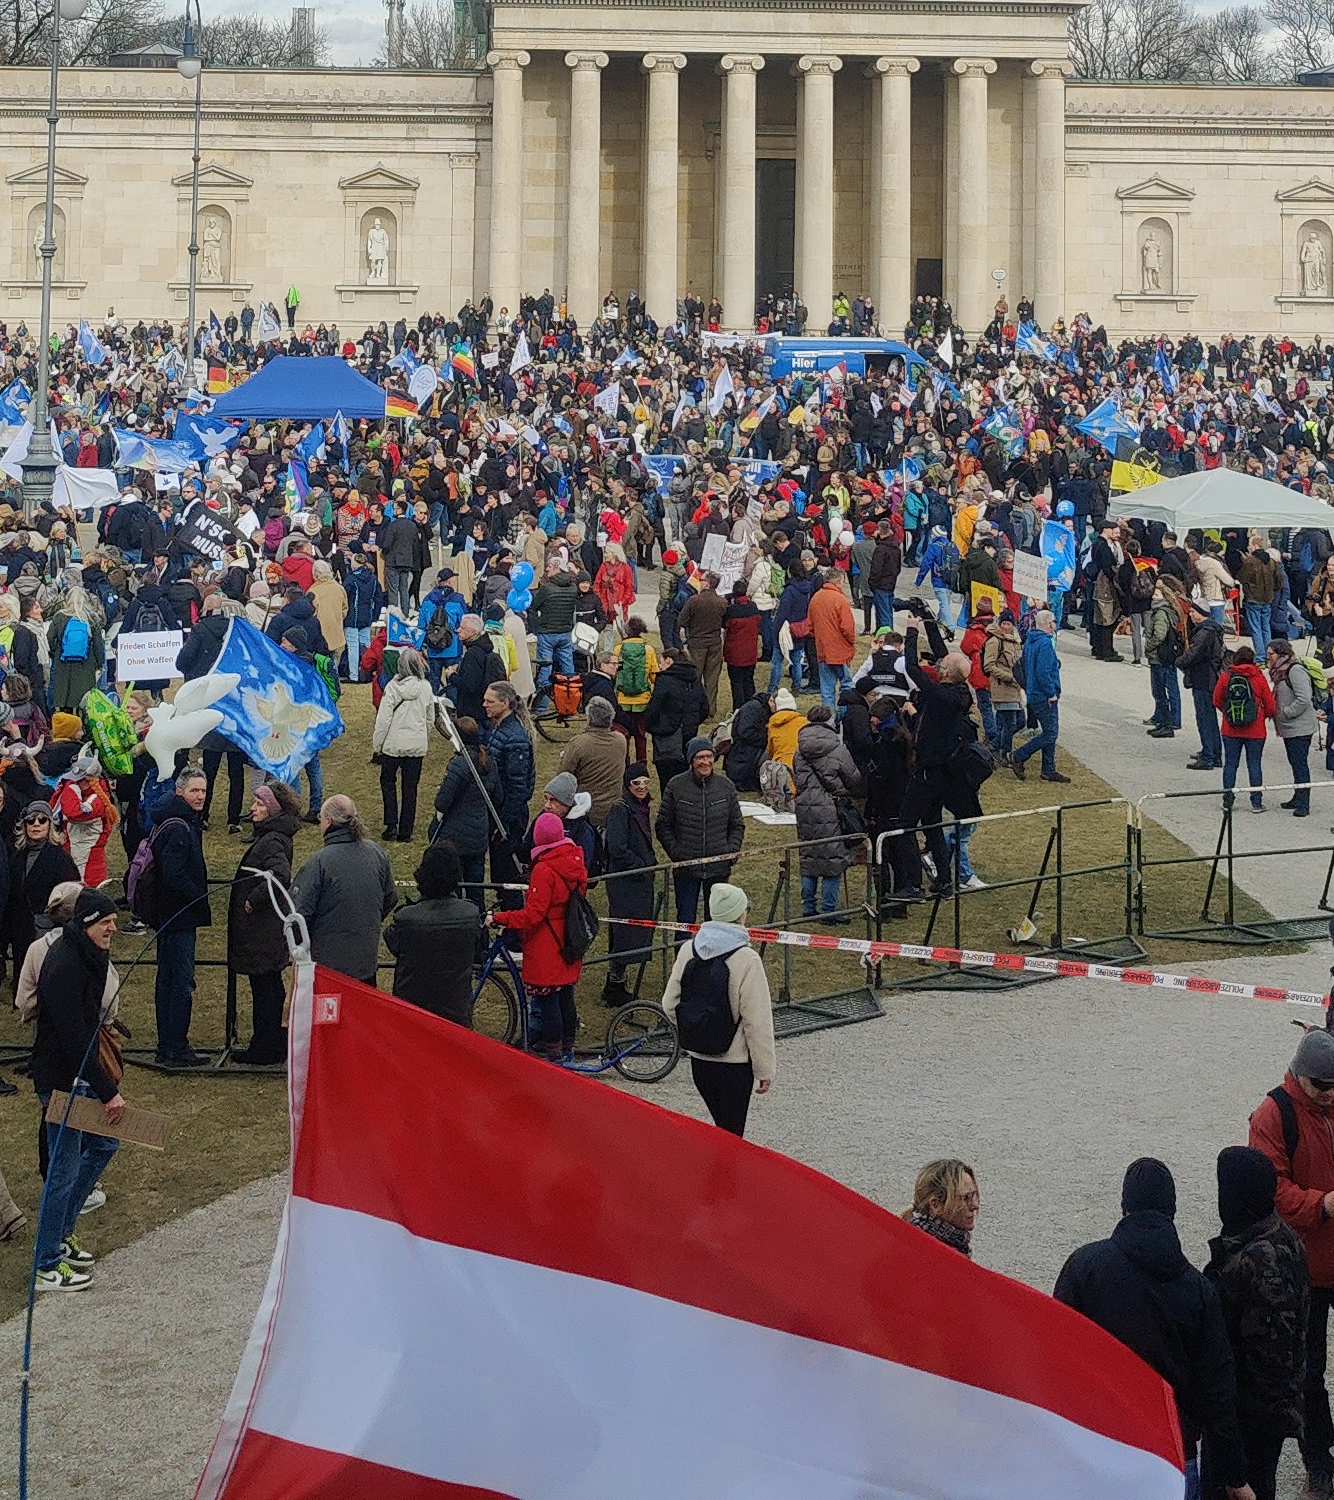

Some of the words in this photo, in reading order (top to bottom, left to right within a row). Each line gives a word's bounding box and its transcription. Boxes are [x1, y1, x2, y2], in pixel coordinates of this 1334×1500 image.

[120, 642, 146, 651] Frieden
[147, 640, 181, 649] Schaffen
[127, 658, 146, 666] Ohne
[147, 656, 174, 664] Waffen
